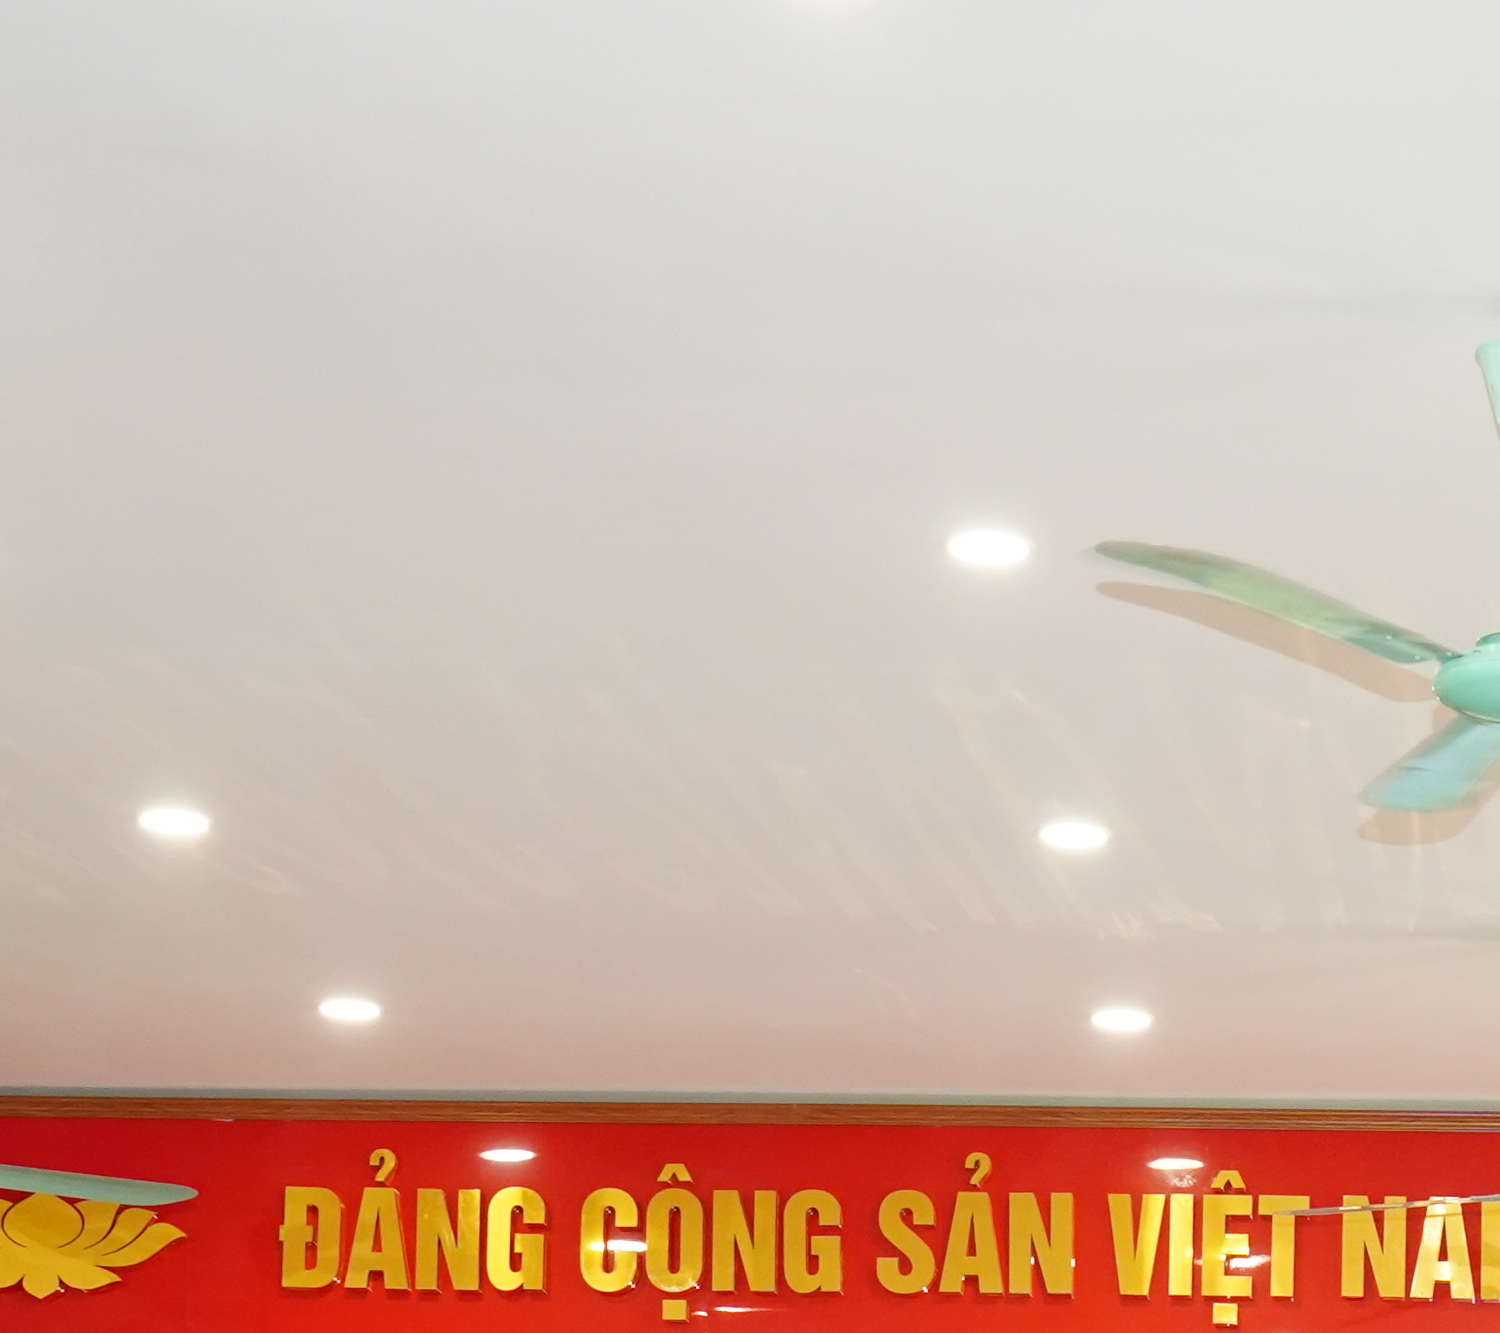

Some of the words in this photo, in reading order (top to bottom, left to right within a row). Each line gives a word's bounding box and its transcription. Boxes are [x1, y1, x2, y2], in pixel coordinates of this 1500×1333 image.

[281, 1148, 549, 1292] ĐẢNG
[580, 1163, 843, 1322] CỘNG
[878, 1152, 1075, 1297] SẢN
[1109, 1170, 1310, 1325] VIỆT
